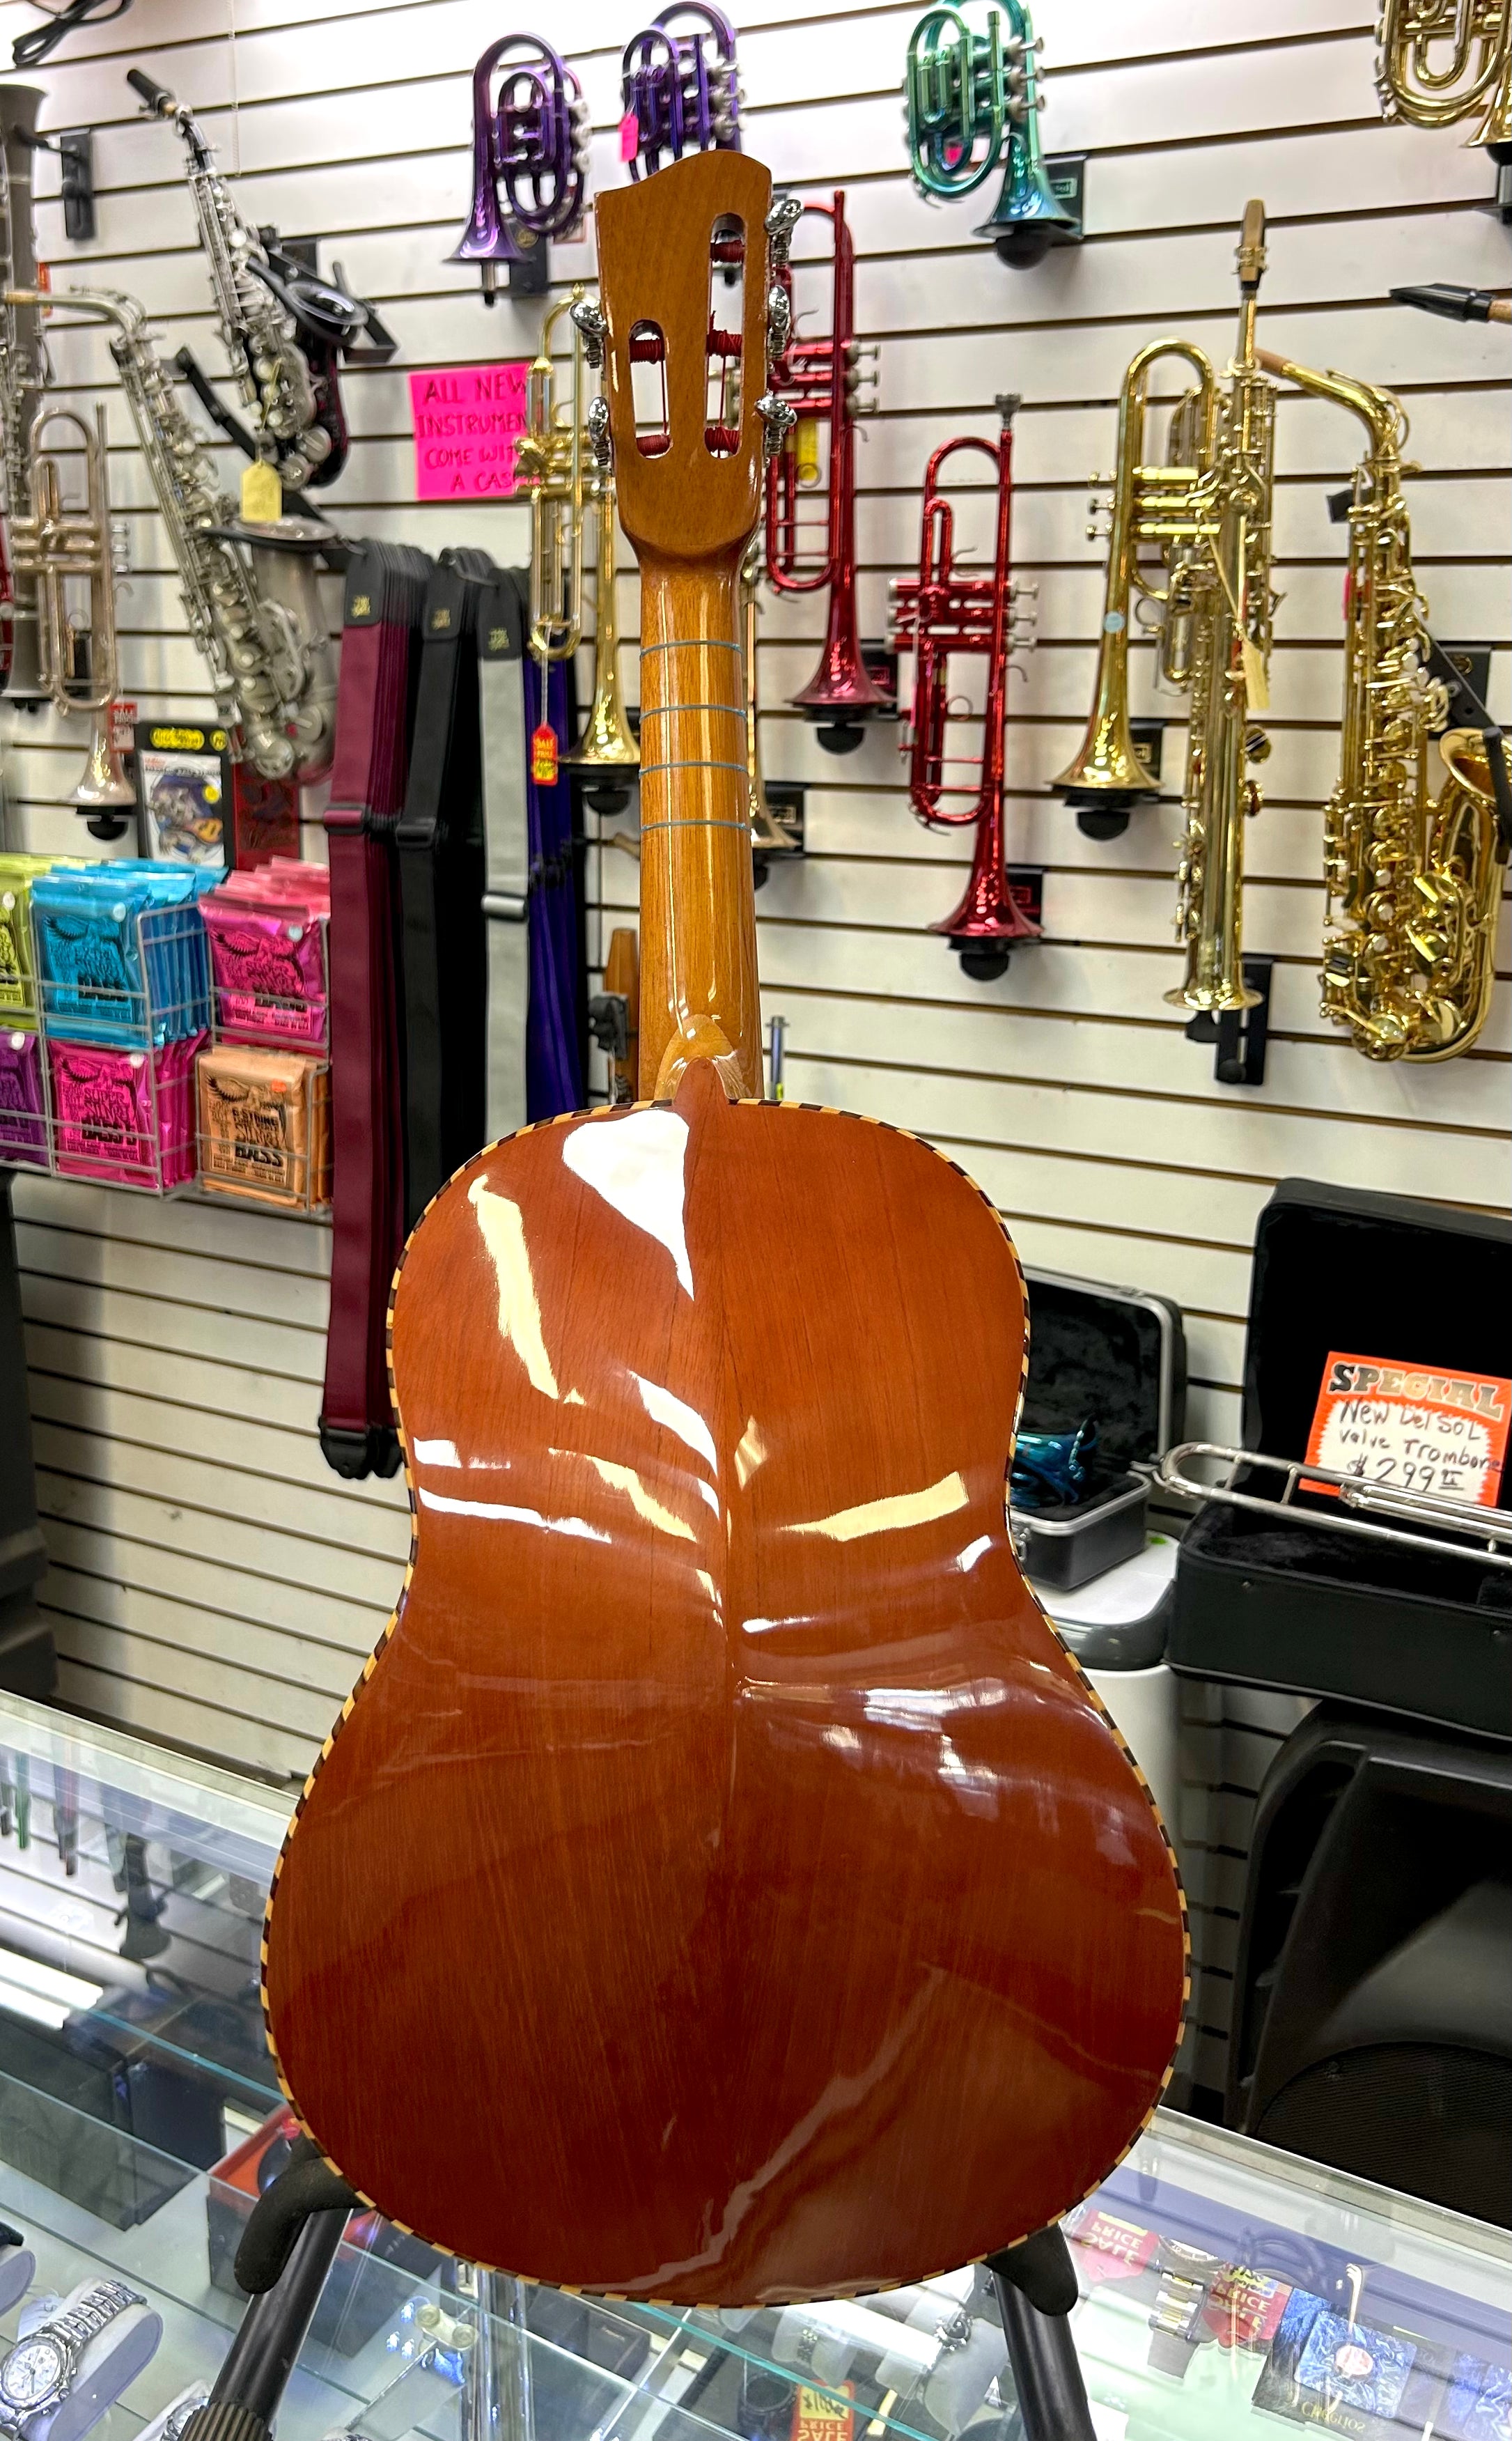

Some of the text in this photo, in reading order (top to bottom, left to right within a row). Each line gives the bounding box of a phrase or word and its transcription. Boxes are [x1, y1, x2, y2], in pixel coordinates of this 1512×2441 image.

[422, 380, 462, 405] ALL
[418, 412, 526, 438] INSTRUMEN
[425, 444, 514, 470] COME WIT
[451, 471, 516, 493] A CAS
[1327, 1362, 1504, 1422] SPECIAL
[1403, 1437, 1503, 1474] Trombone
